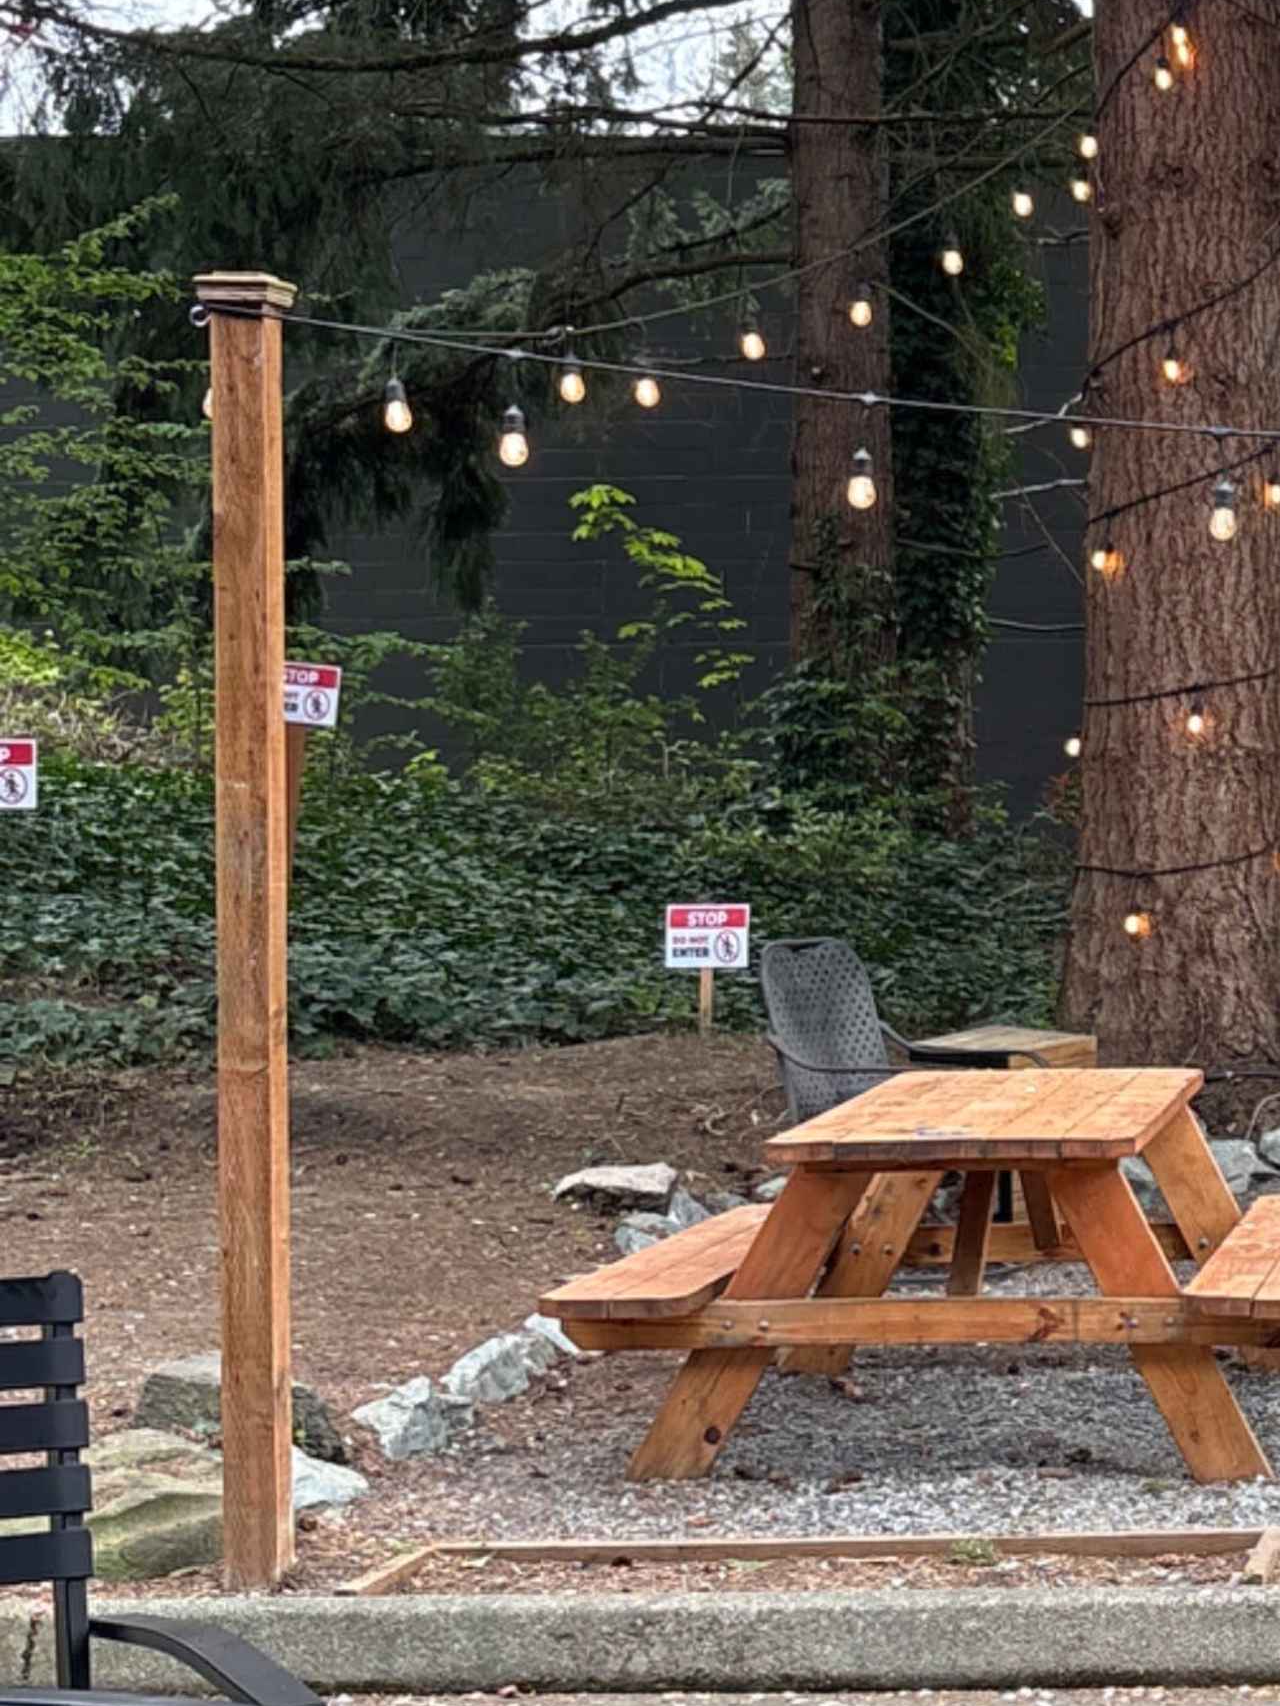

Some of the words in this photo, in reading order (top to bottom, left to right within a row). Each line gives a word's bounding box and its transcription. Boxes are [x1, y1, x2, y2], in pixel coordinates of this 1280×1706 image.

[687, 911, 728, 926] STOP
[690, 936, 709, 944] NOT
[672, 948, 709, 957] ENTER
